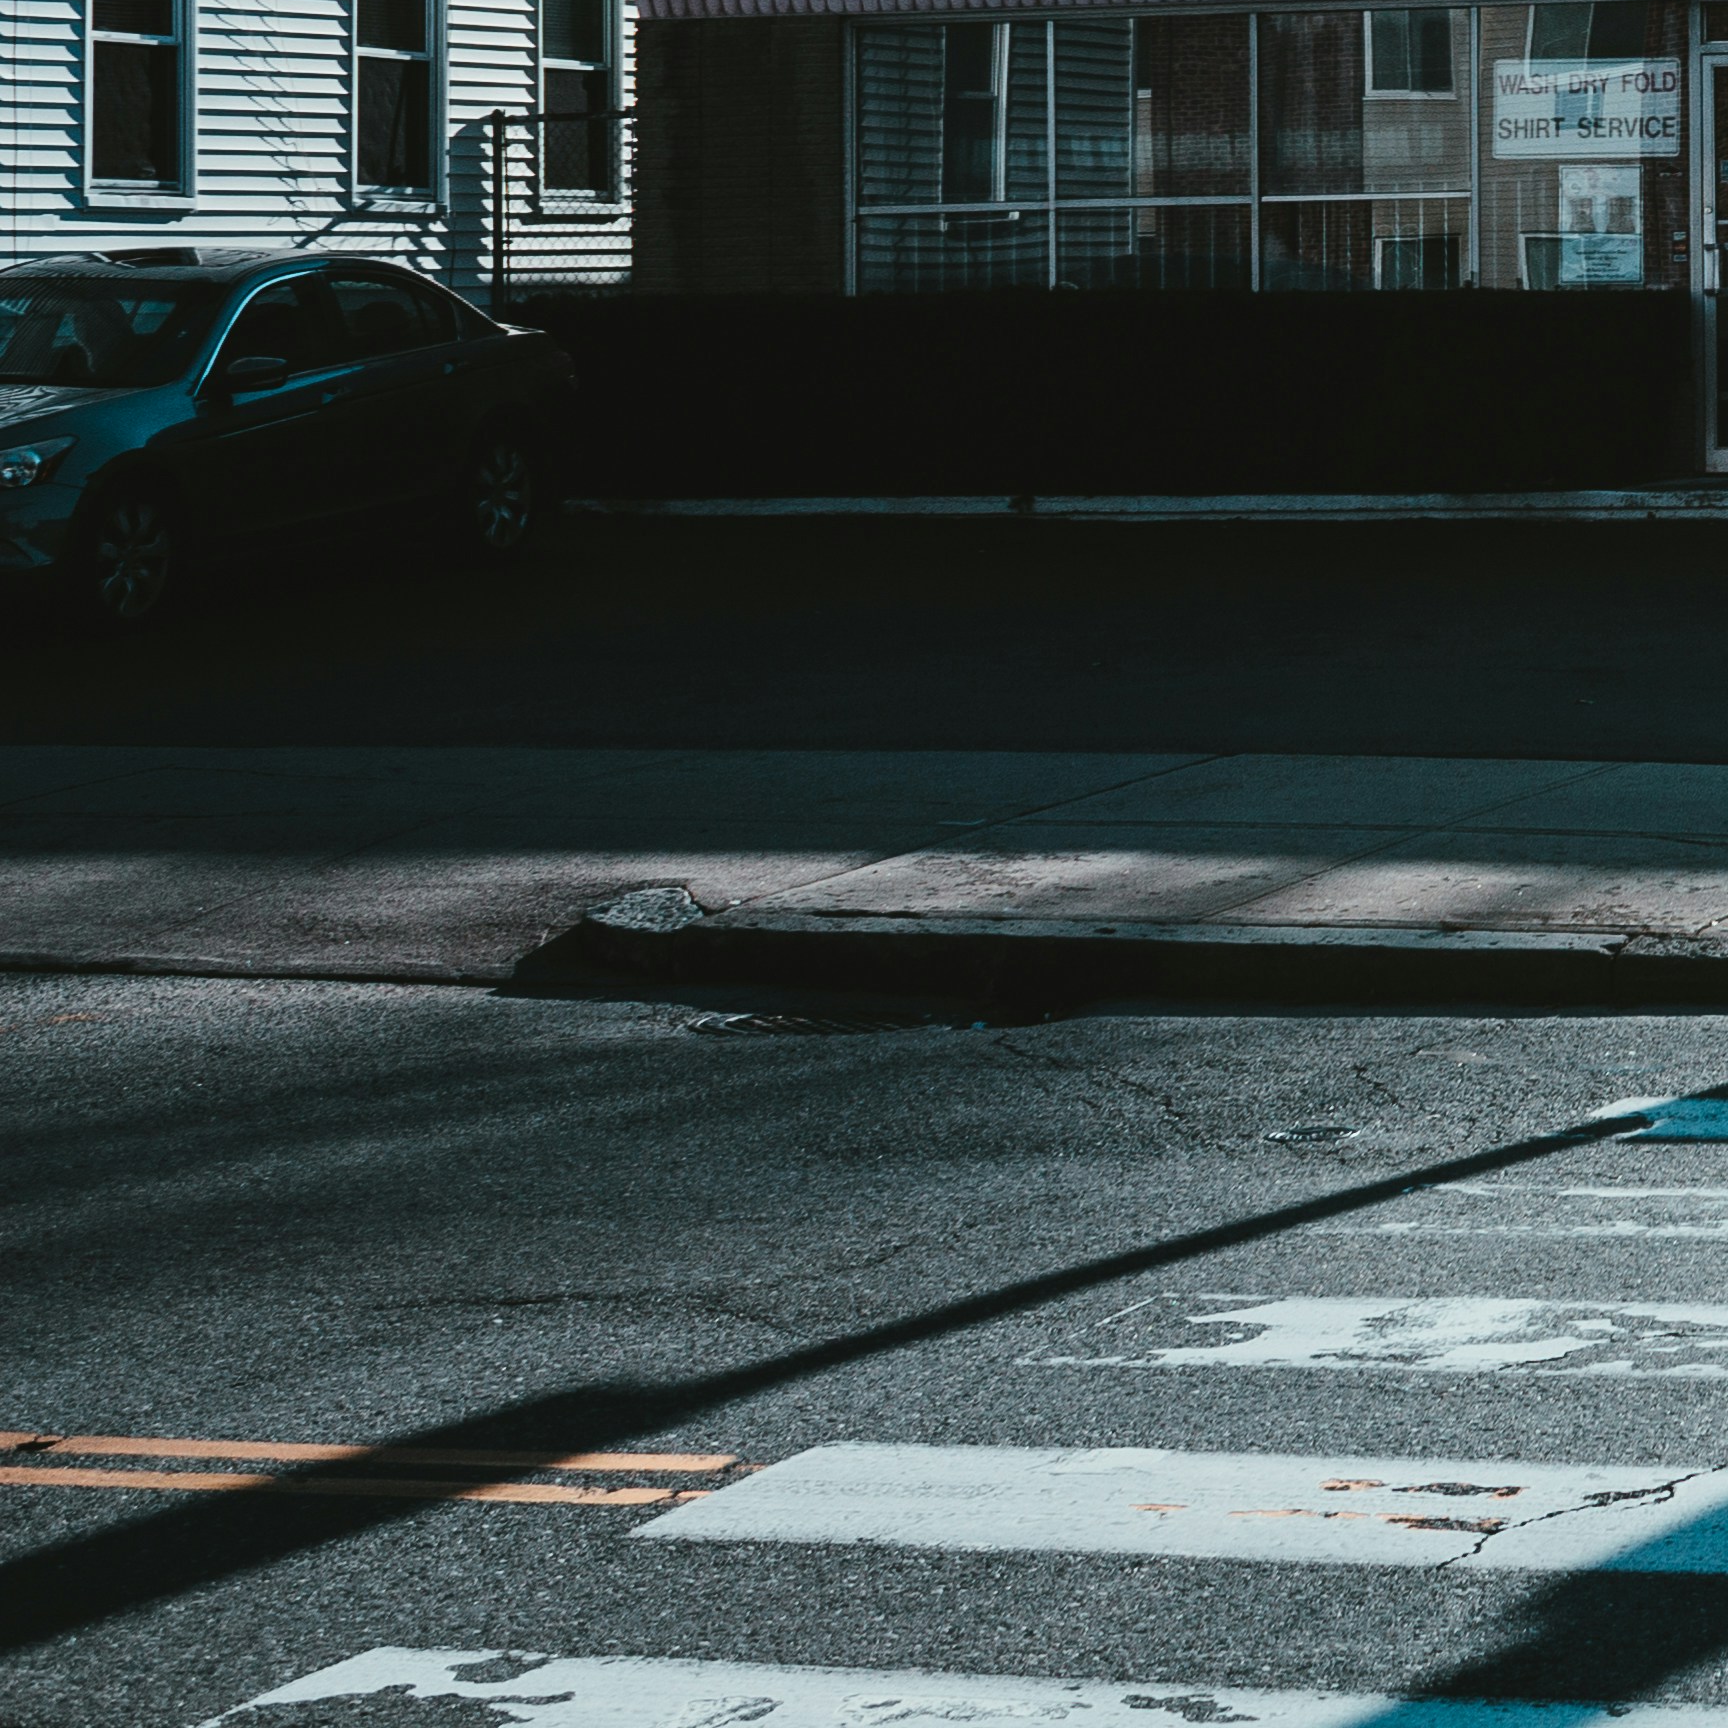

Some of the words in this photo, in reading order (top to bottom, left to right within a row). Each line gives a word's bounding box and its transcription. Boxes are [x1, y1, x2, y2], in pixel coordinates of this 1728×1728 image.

[1499, 73, 1557, 94] WASH
[1568, 73, 1609, 94] DRY
[1622, 72, 1677, 94] FOLD
[1498, 117, 1565, 139] SHIRT
[1577, 116, 1676, 139] SERVICE
